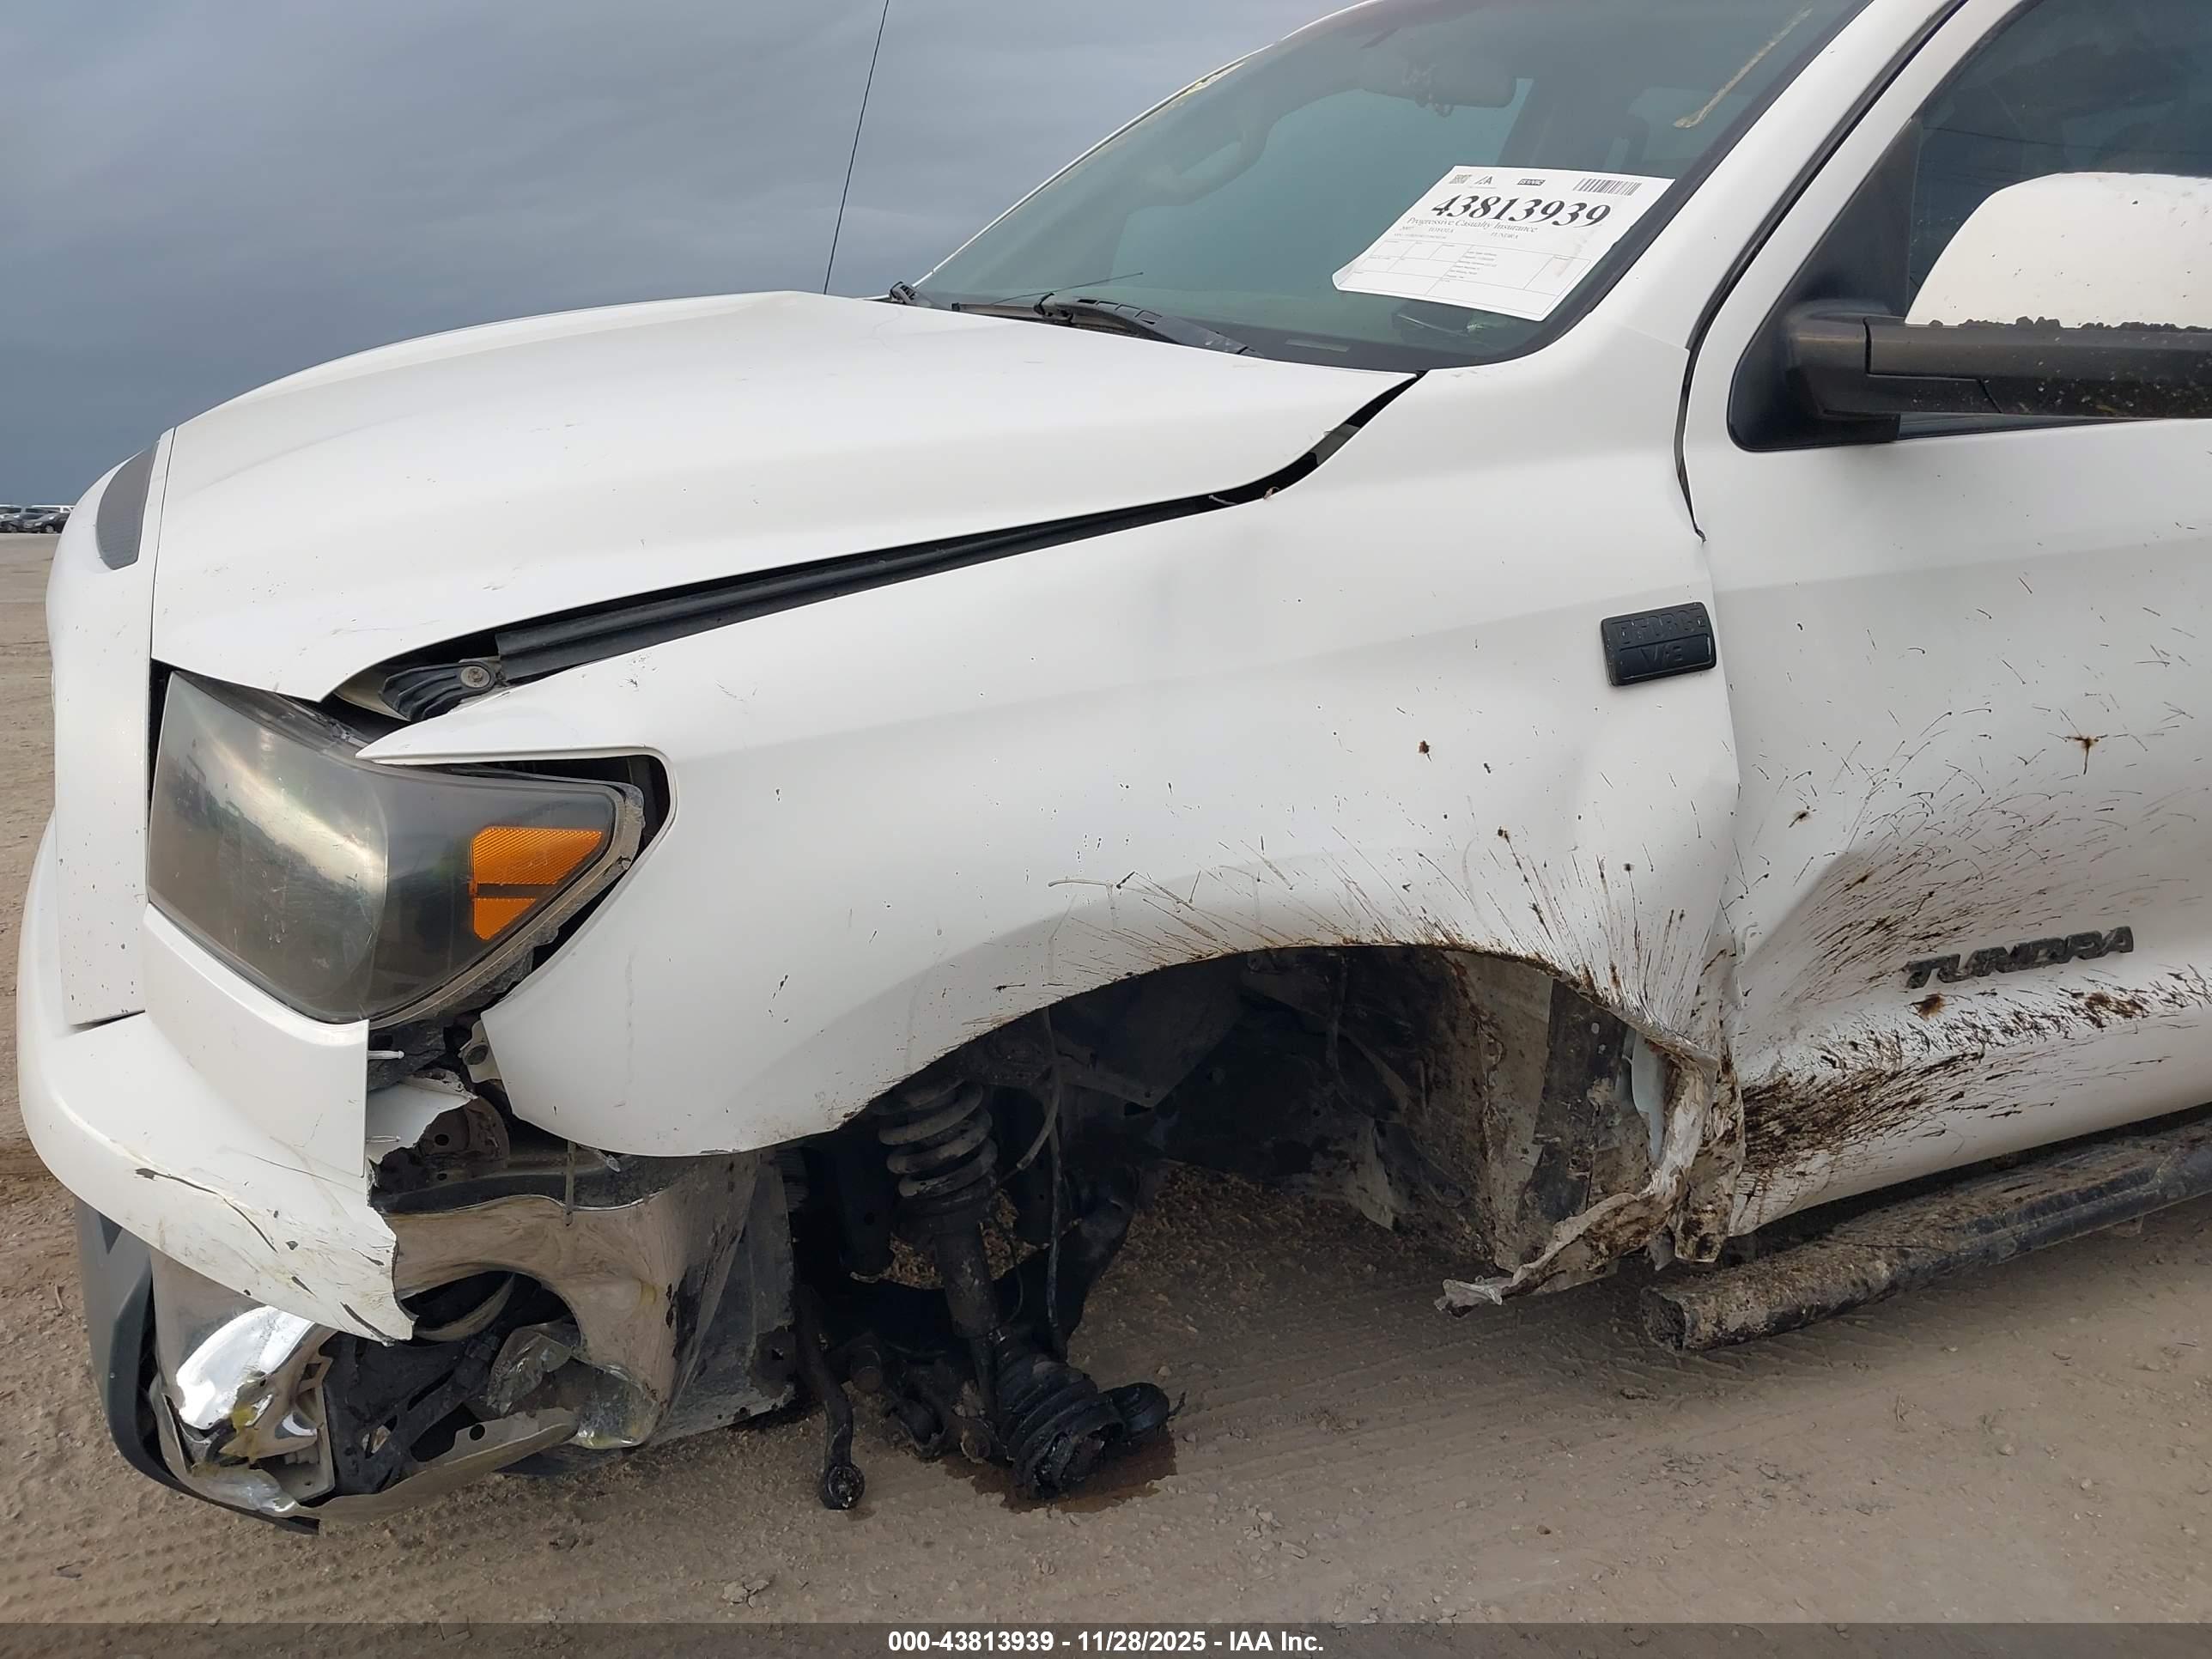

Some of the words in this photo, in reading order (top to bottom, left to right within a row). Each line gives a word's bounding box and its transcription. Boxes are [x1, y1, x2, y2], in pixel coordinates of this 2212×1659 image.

[1407, 217, 1455, 227] Progressive
[1455, 219, 1492, 230] Casualty
[1494, 222, 1538, 234] Insurance
[1431, 194, 1612, 228] 43813939
[1905, 926, 2134, 989] TUNDRA
